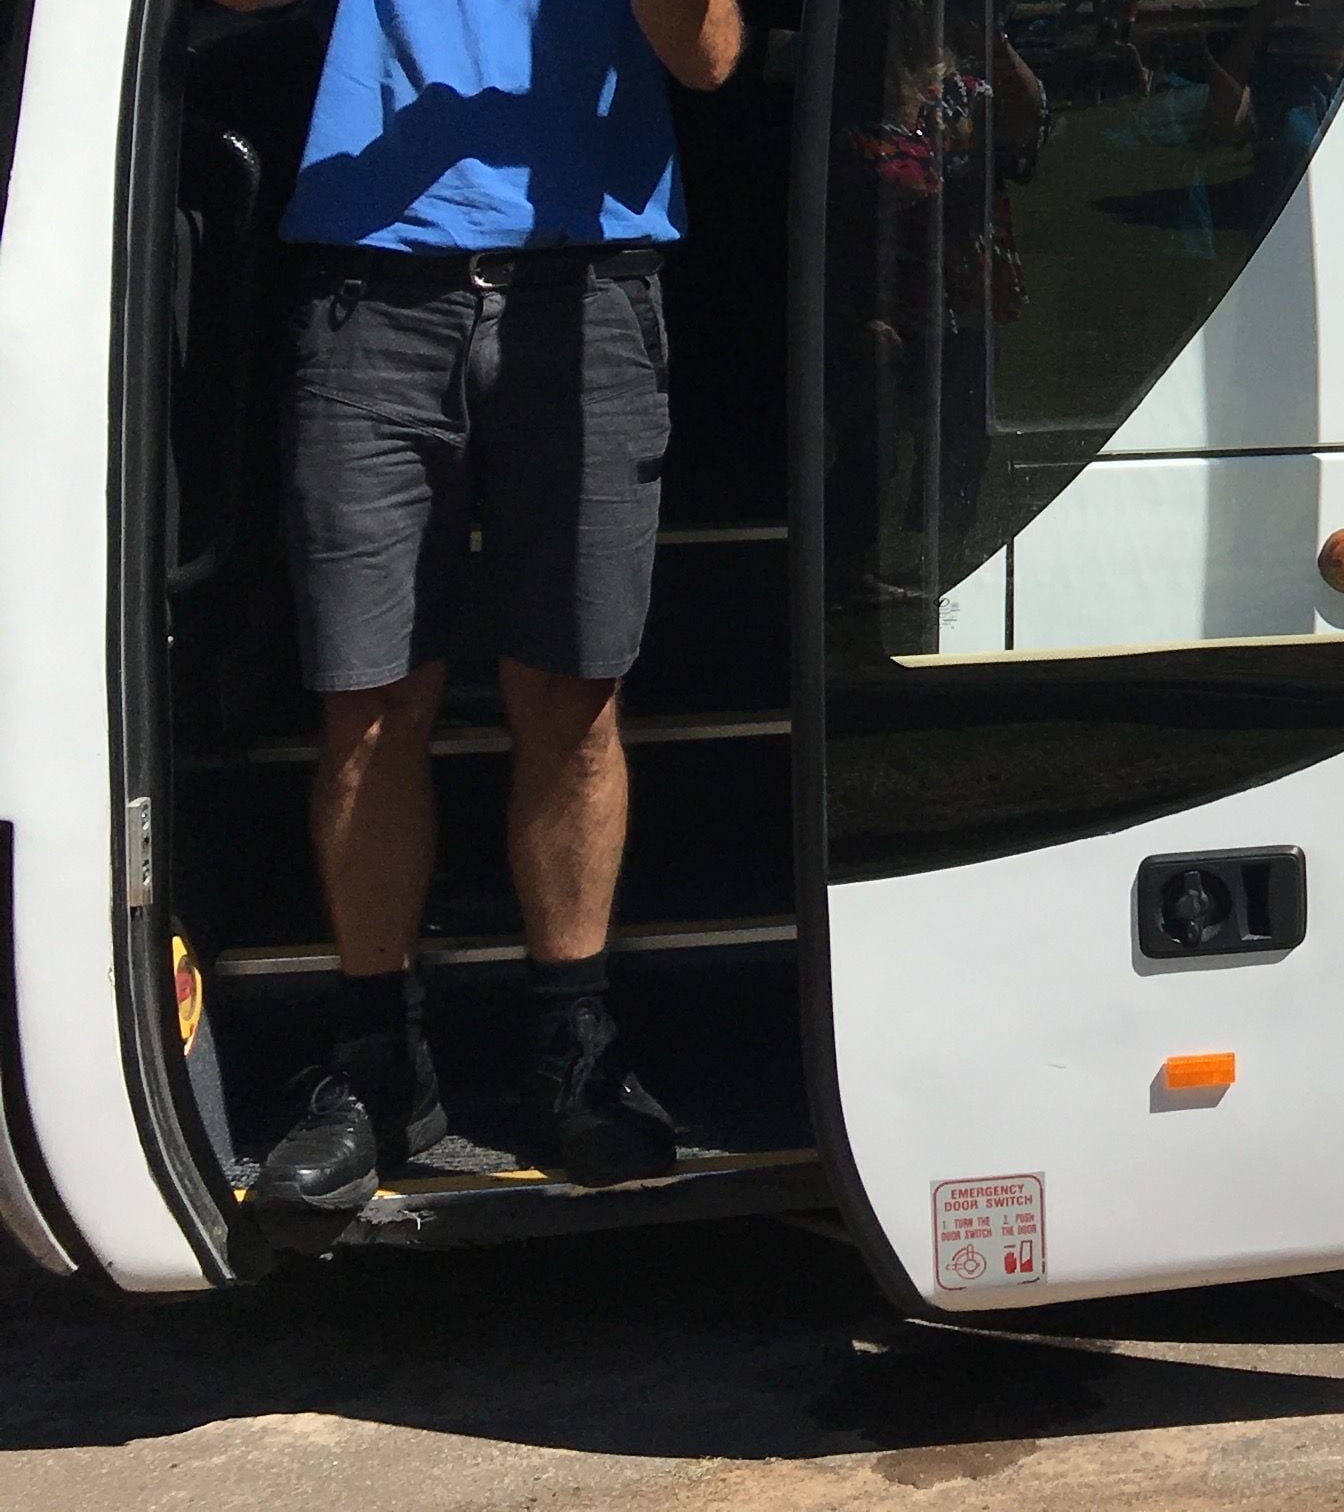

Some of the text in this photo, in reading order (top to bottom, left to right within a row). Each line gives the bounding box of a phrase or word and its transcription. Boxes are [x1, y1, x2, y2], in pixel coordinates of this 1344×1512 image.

[950, 1183, 1025, 1199] EMERGENCY
[944, 1195, 1033, 1212] DOOR SWITCH
[954, 1217, 973, 1229] TURN
[977, 1216, 990, 1227] THE
[941, 1228, 992, 1242] DOOR SWITCH
[1002, 1226, 1014, 1236] THE
